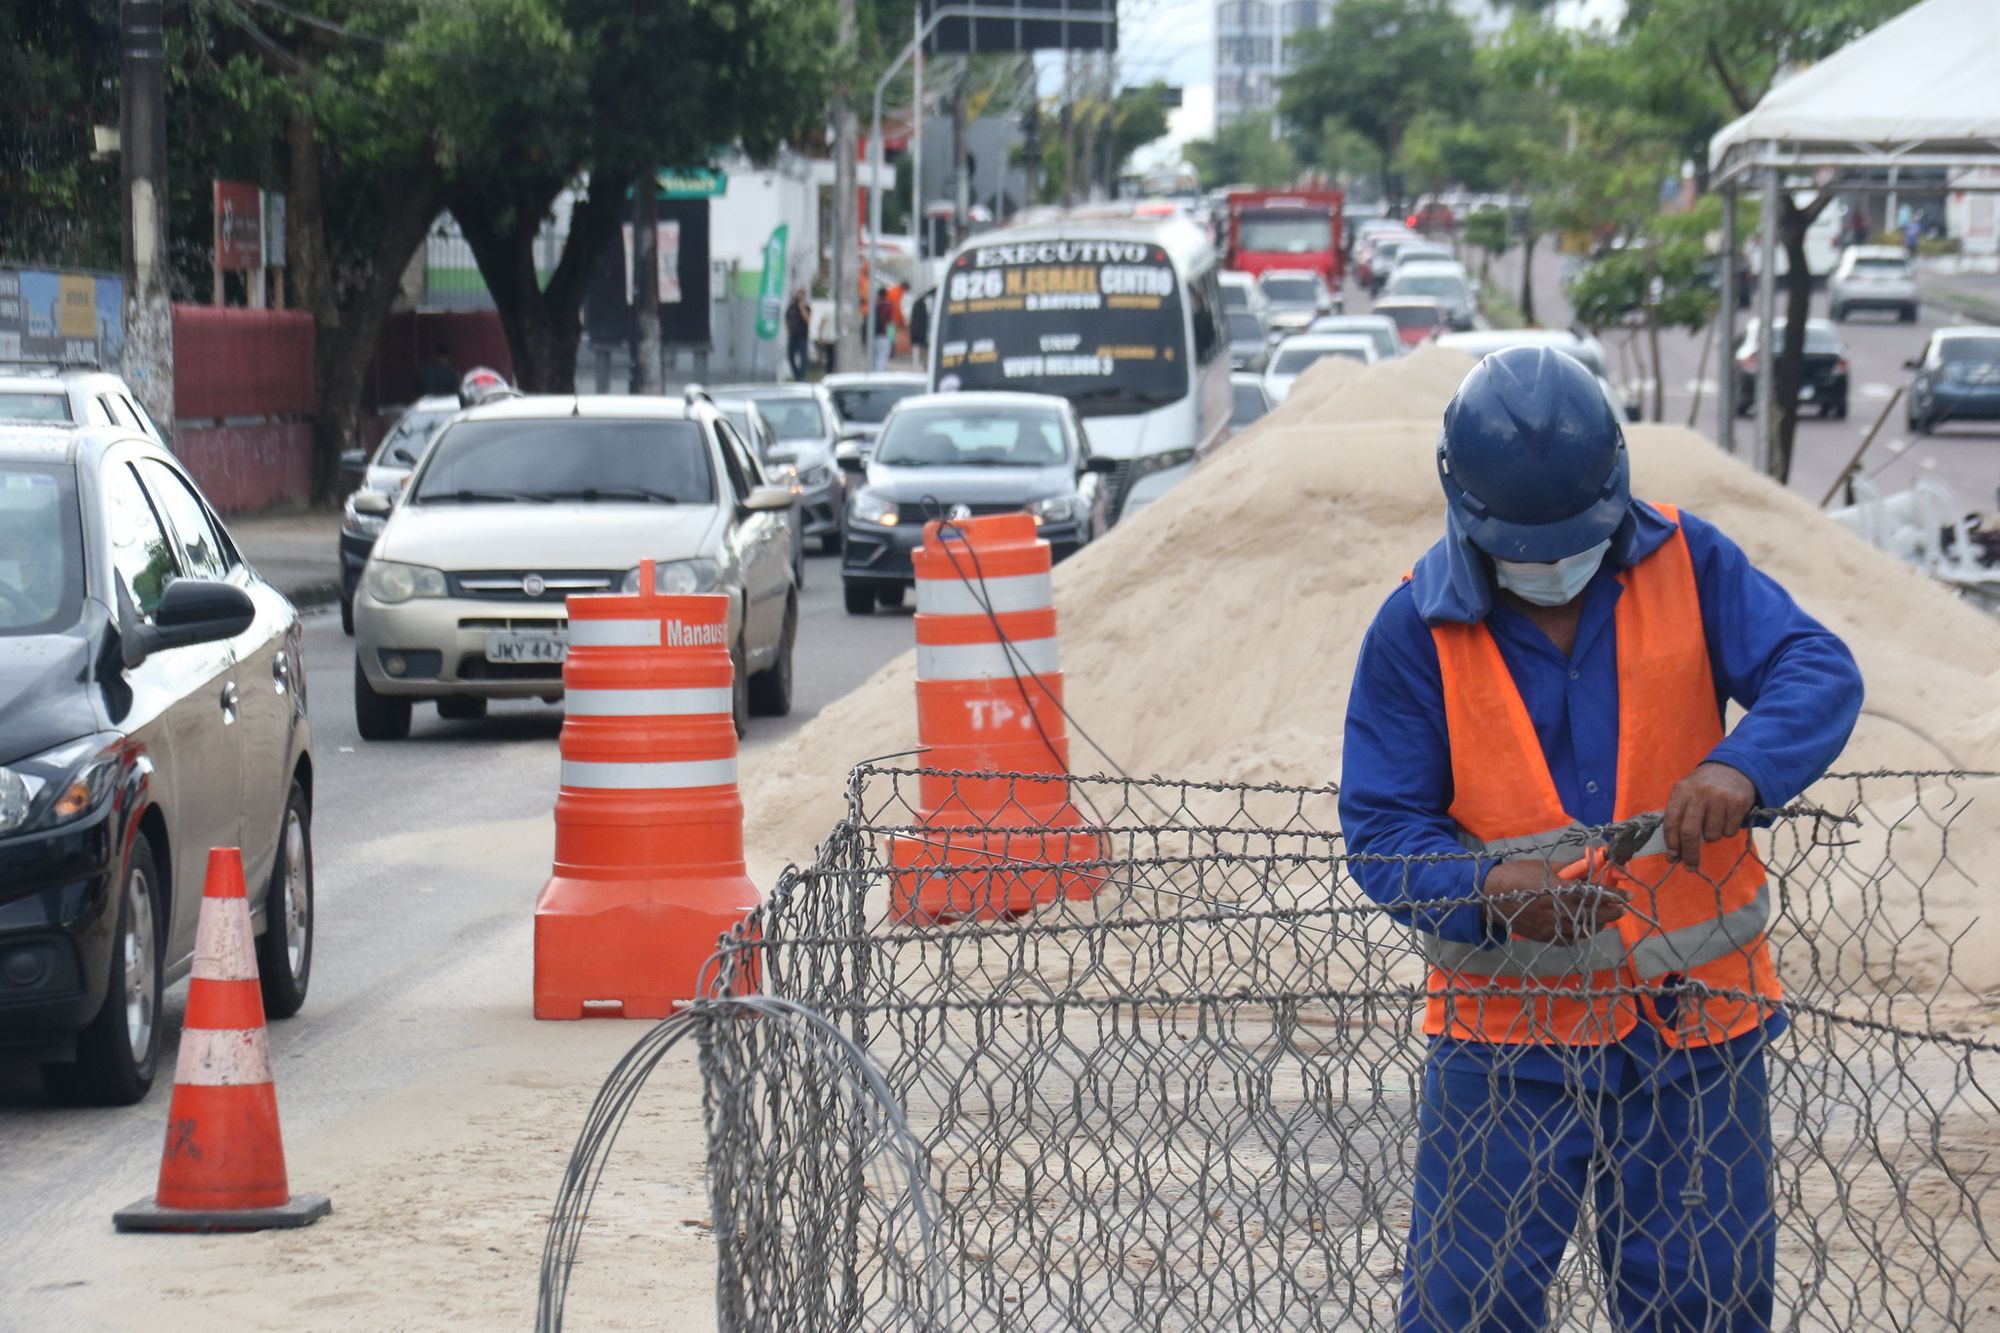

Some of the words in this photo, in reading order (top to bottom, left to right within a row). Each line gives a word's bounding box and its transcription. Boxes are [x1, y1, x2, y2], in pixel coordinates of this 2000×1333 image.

[977, 243, 1147, 267] EXECUTIVO
[950, 269, 1004, 302] 826
[1100, 265, 1173, 297] CENTRO
[532, 640, 568, 659] 447
